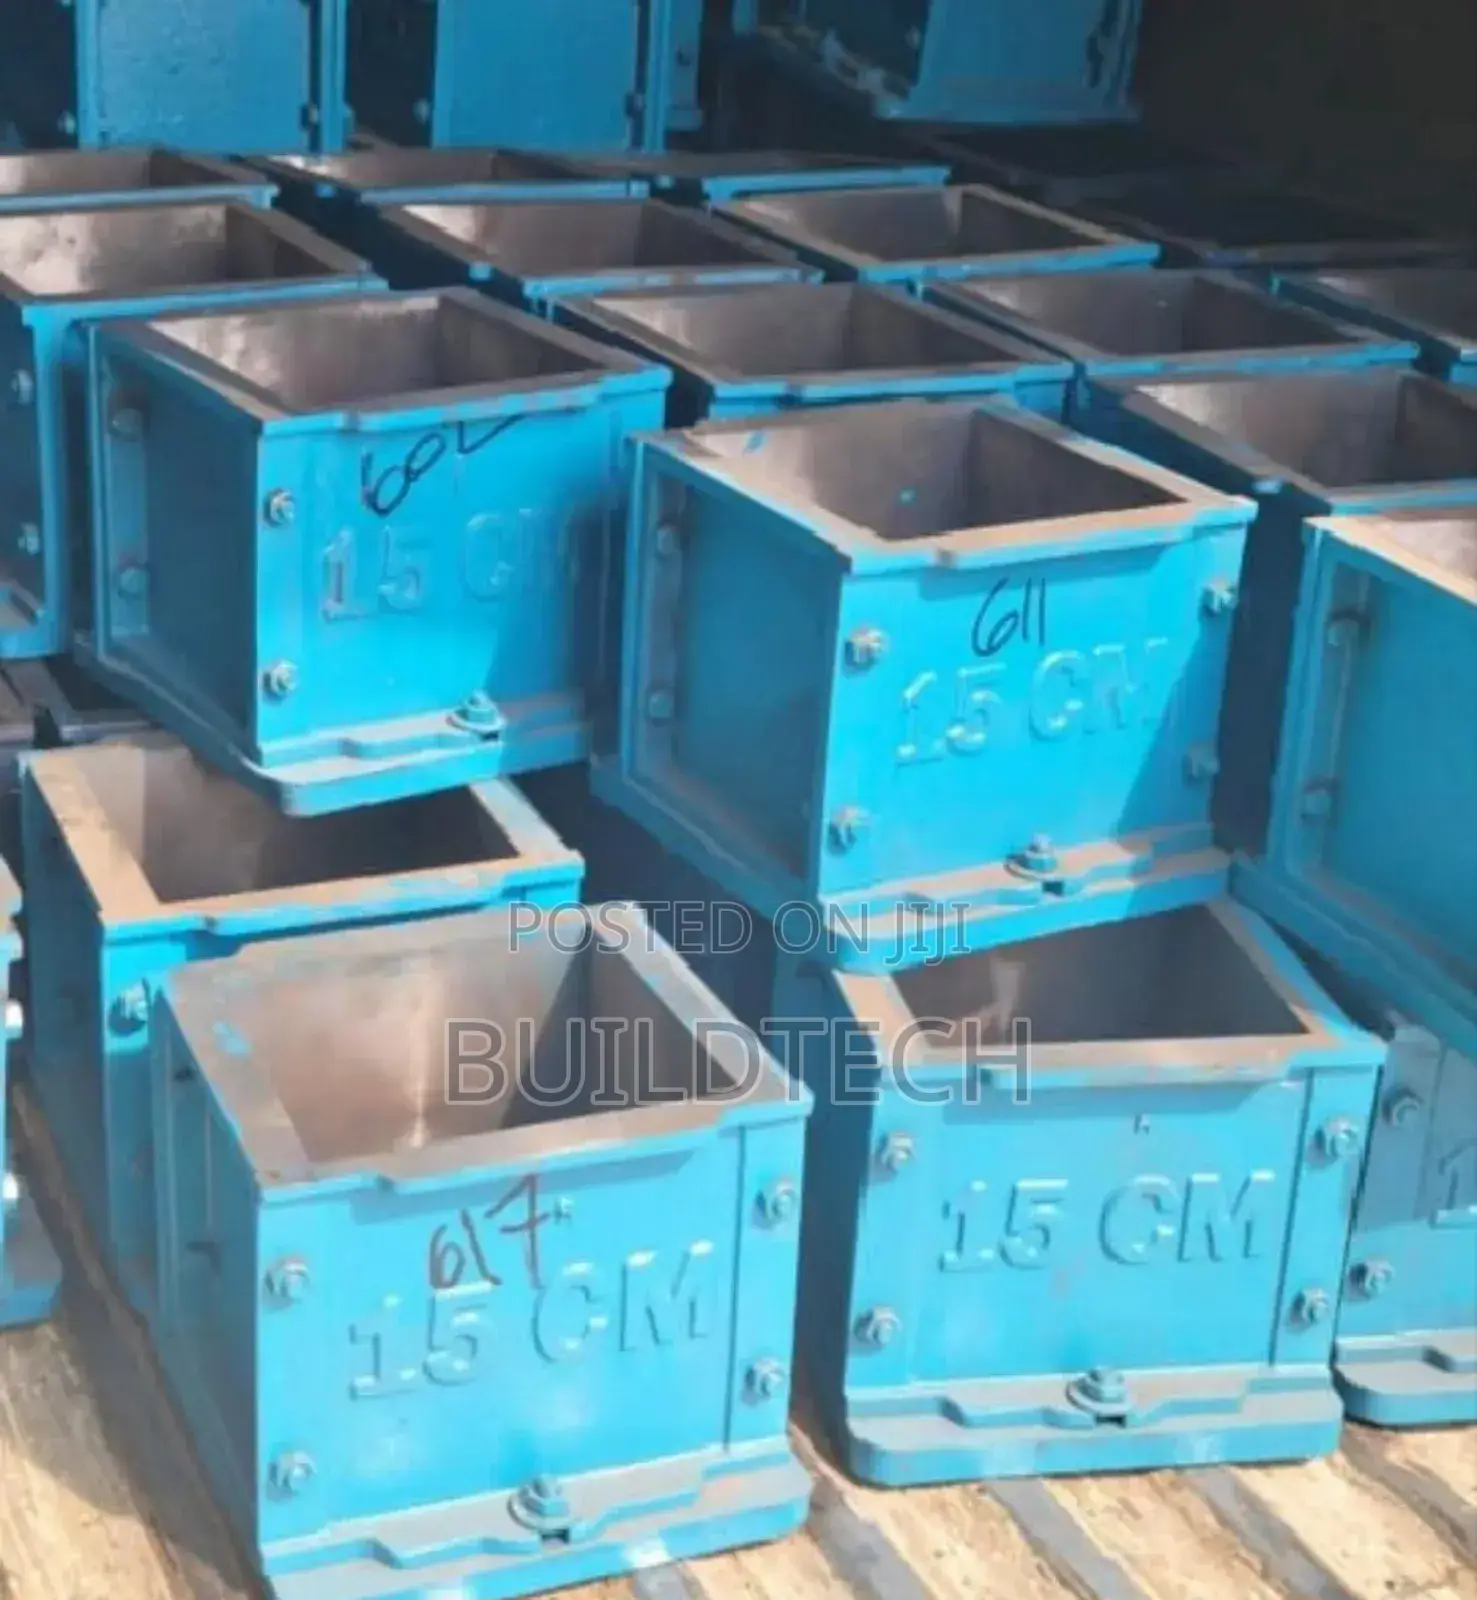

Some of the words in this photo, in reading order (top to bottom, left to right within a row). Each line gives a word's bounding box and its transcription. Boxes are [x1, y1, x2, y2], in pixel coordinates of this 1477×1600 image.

[321, 523, 428, 623] 15
[970, 577, 1047, 657] 611
[895, 664, 1006, 768] 15
[428, 1172, 553, 1290] 617
[936, 1177, 1069, 1273] 15
[1097, 1168, 1276, 1265] CM
[348, 1279, 495, 1400] 15
[530, 1239, 715, 1363] CM
